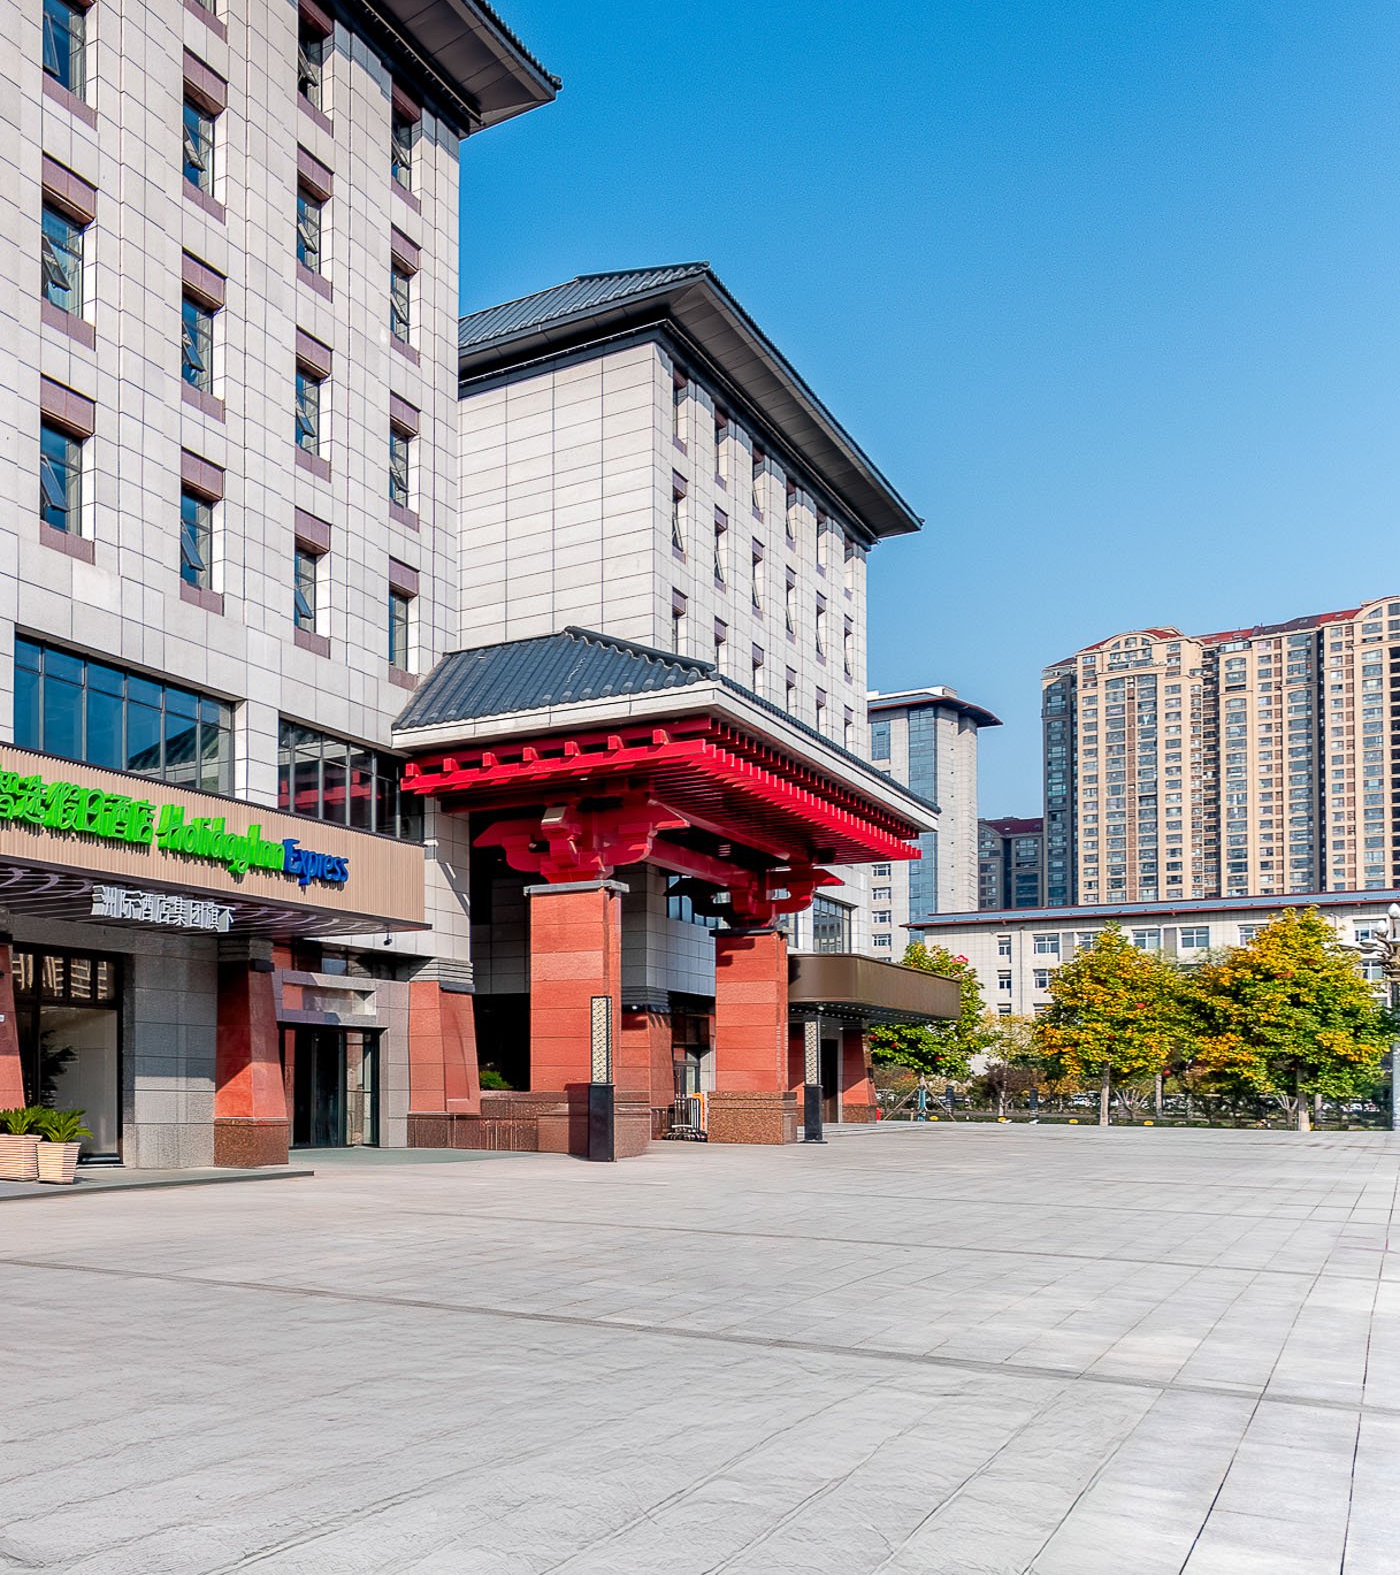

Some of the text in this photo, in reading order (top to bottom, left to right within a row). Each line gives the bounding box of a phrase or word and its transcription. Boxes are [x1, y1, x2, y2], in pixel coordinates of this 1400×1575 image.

[155, 804, 249, 874] Holiday
[282, 838, 349, 886] Express
[91, 885, 236, 933] 洲际酒店集团旗下
